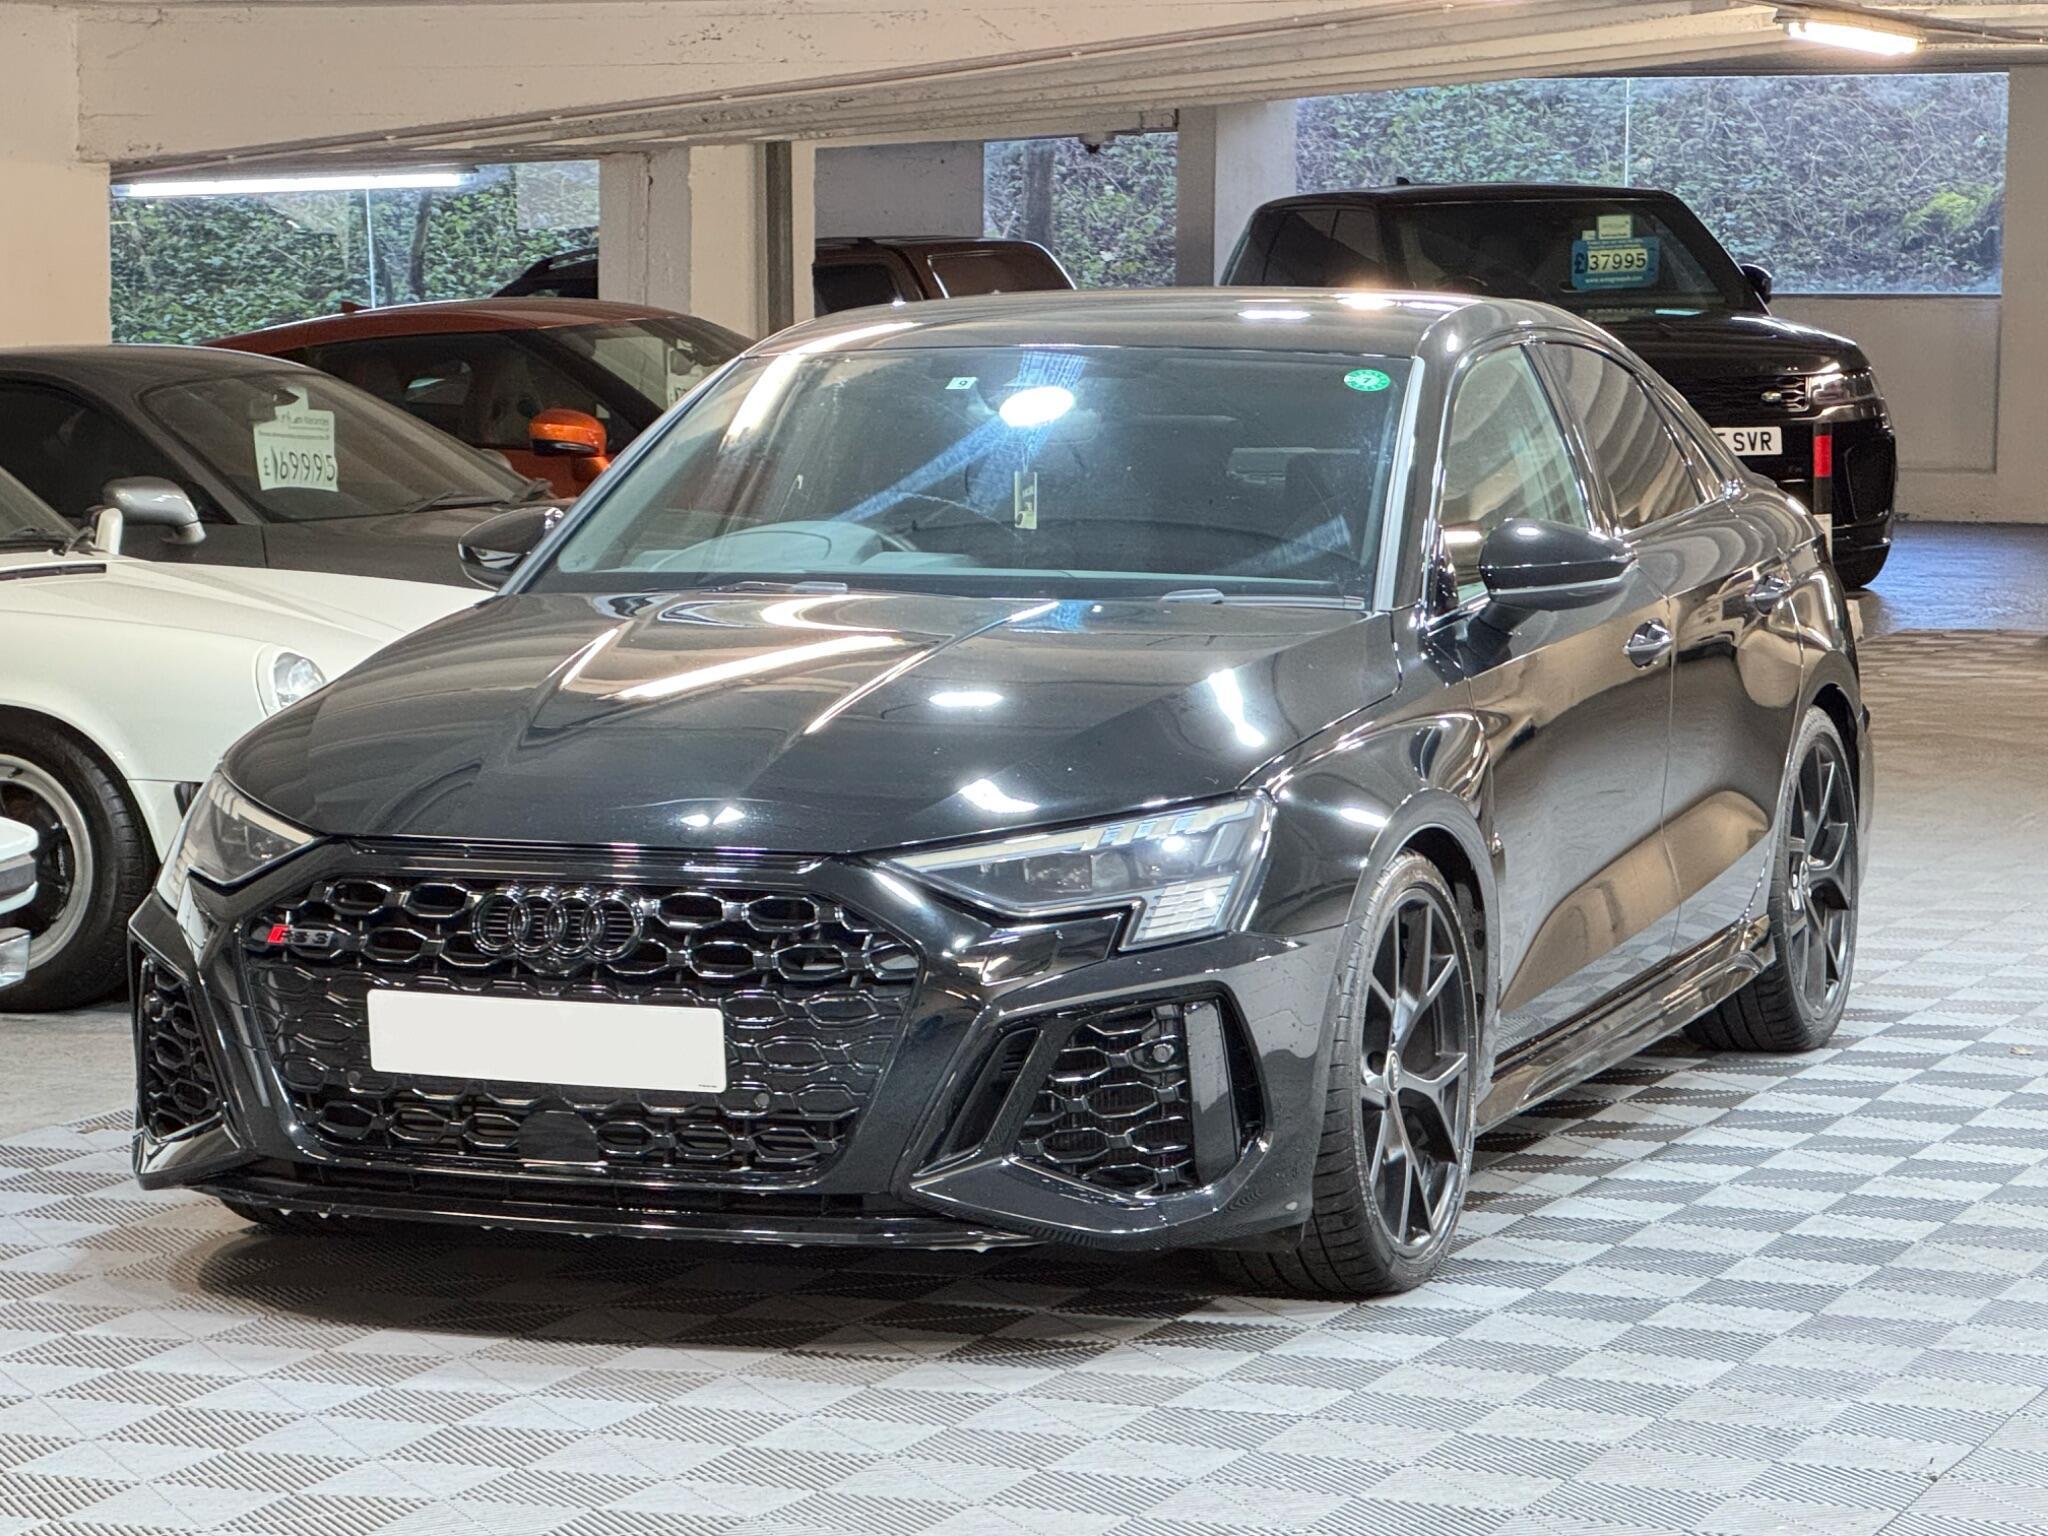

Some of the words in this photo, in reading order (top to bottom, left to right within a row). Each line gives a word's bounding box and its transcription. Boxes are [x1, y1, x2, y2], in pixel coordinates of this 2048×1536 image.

[1575, 251, 1647, 274] £37995
[1733, 431, 1772, 451] SVR
[263, 445, 336, 482] £169995
